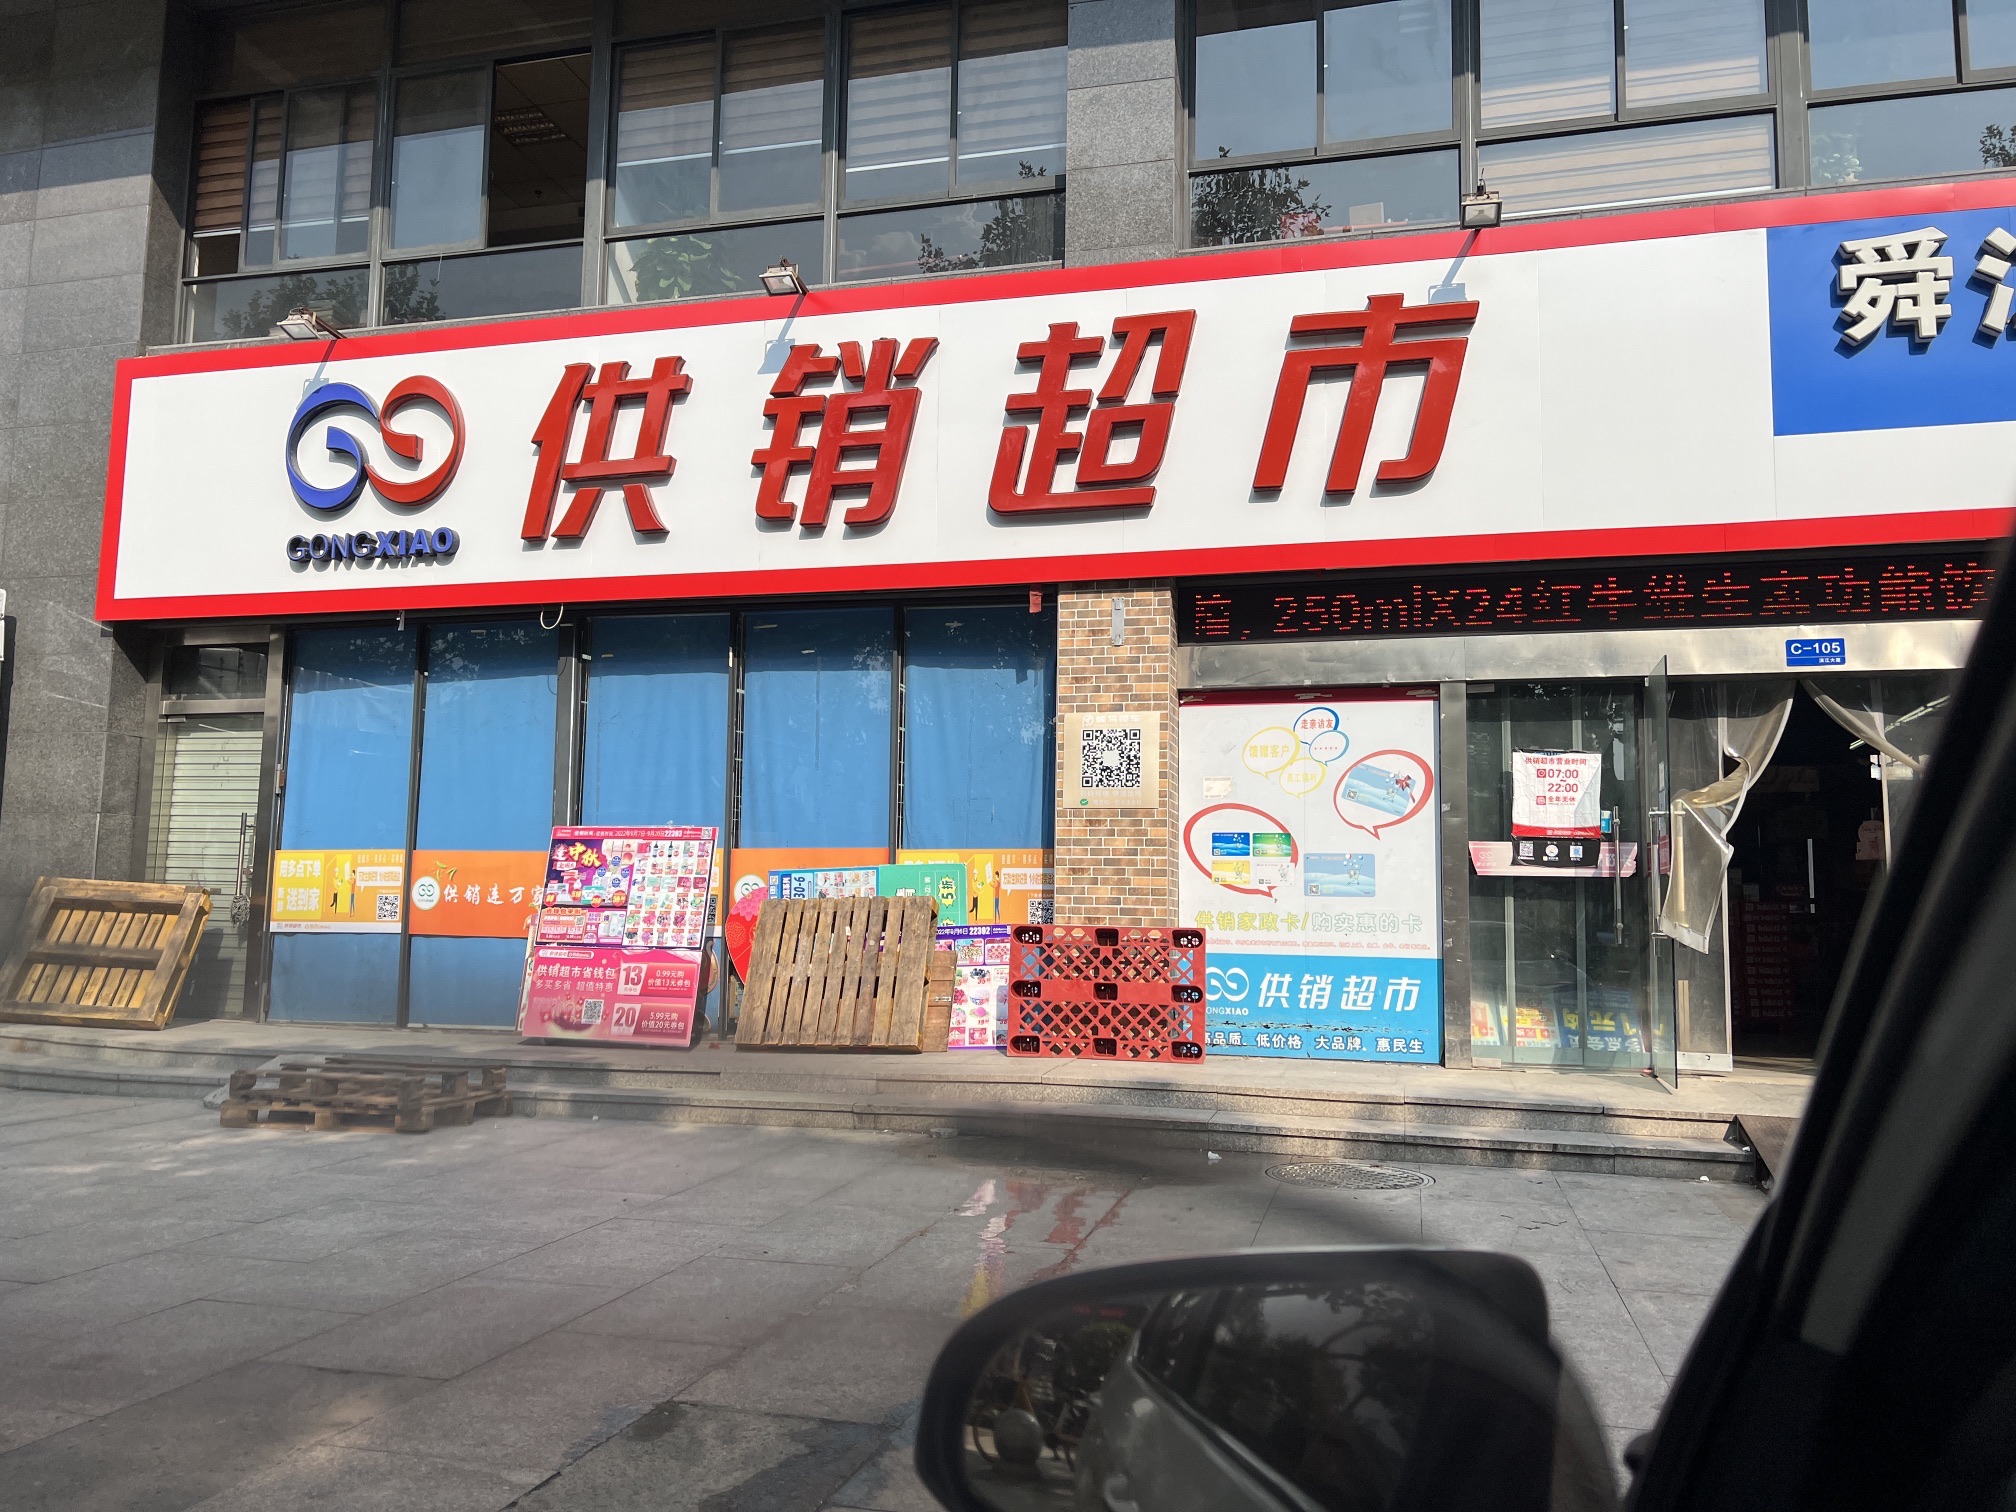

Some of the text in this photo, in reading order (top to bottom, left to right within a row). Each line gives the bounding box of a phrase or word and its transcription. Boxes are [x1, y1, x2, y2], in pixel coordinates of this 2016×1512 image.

[521, 293, 1479, 543] 供销超市
[287, 527, 459, 565] GONGXIAO
[1790, 642, 1841, 654] C-105
[1300, 718, 1333, 730] 走亲访友
[1249, 744, 1289, 758] 馈赠客户
[1525, 757, 1587, 766] 供销超市营业时间
[1547, 769, 1579, 779] 07:00
[1547, 783, 1579, 793] 22:00
[941, 880, 953, 900] 5折
[1195, 910, 1422, 934] 供销家政卡/购实惠的卡
[537, 964, 616, 980] 供销超市省钱包
[623, 966, 643, 986] 13
[656, 970, 685, 978] 0.99元购
[535, 979, 614, 992] 多买多省 超值特惠
[648, 978, 691, 988] 价值13元券包
[1258, 973, 1421, 1012] 供销超市
[614, 1006, 636, 1028] 20
[650, 1012, 679, 1021] 5.99元购
[1205, 1006, 1249, 1016] ONGXIAO
[641, 1020, 685, 1030] 价值20元券包
